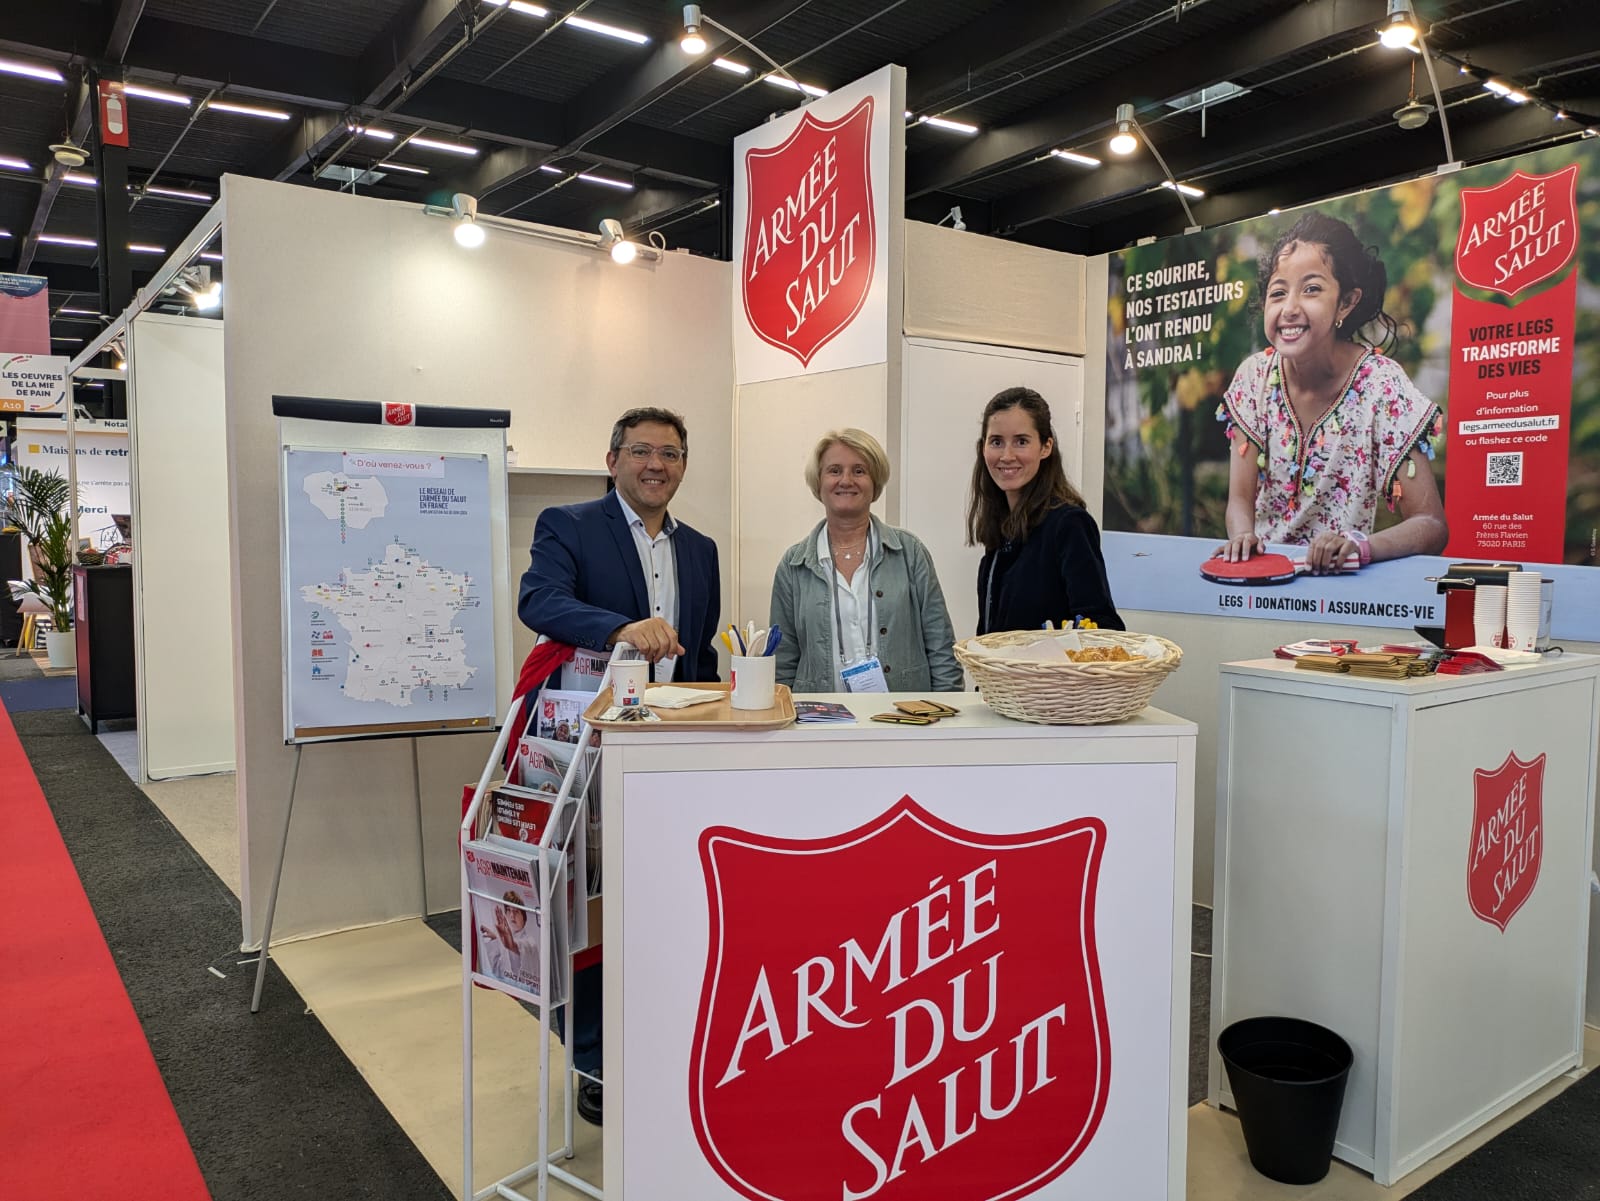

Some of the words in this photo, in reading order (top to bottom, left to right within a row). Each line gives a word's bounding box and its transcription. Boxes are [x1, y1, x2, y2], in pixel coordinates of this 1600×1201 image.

[749, 136, 838, 282] ARMÉE
[1461, 182, 1545, 257] ARMÉE
[799, 187, 838, 274] DU
[1509, 208, 1546, 252] DU
[1495, 219, 1565, 286] SALUT
[786, 213, 860, 341] SALUT
[1126, 274, 1143, 293] CE
[1145, 260, 1210, 289] SOURIRE,
[1126, 298, 1152, 319] NOS
[1155, 280, 1244, 313] TESTATEURS
[1125, 322, 1162, 345] L'ONT
[1164, 313, 1212, 338] RENDU
[1469, 323, 1514, 342] VOTRE
[1517, 318, 1554, 337] LEGS
[1124, 349, 1134, 370] À
[1136, 343, 1193, 368] SANDRA
[1196, 342, 1202, 360] !
[1461, 337, 1561, 362] TRANSFORME
[21, 372, 63, 381] OEUVRES
[1478, 363, 1505, 379] DES
[1508, 360, 1541, 376] VIES
[11, 380, 24, 388] DE
[1486, 391, 1508, 400] Pour
[1509, 389, 1529, 400] plus
[1476, 404, 1538, 416] d'information
[1463, 418, 1555, 433] legs.armeedusalut.fr
[42, 445, 87, 456] Maisns
[90, 447, 102, 456] de
[1465, 438, 1477, 446] ou
[1479, 436, 1510, 445] flashez
[1524, 433, 1548, 443] code
[357, 459, 377, 468] D'où
[1472, 513, 1499, 521] Armée
[1500, 513, 1511, 521] du
[1512, 513, 1534, 521] Salut
[1482, 522, 1493, 530] 60
[1508, 522, 1522, 530] des
[1475, 531, 1499, 539] Frères
[1500, 531, 1529, 539] Flavien
[1477, 540, 1501, 548] 75020
[1502, 540, 1526, 548] PARIS
[1219, 594, 1243, 608] LEGS
[1255, 596, 1317, 612] DONATIONS
[1328, 600, 1435, 620] ASSURANCES-VIE
[1472, 772, 1527, 872] ARMÉE
[1503, 808, 1526, 866] DU
[1492, 825, 1539, 914] SALUT
[715, 859, 1000, 1089] ARMÉE
[885, 951, 1004, 1089] DU
[841, 1002, 1066, 1201] SALUT
